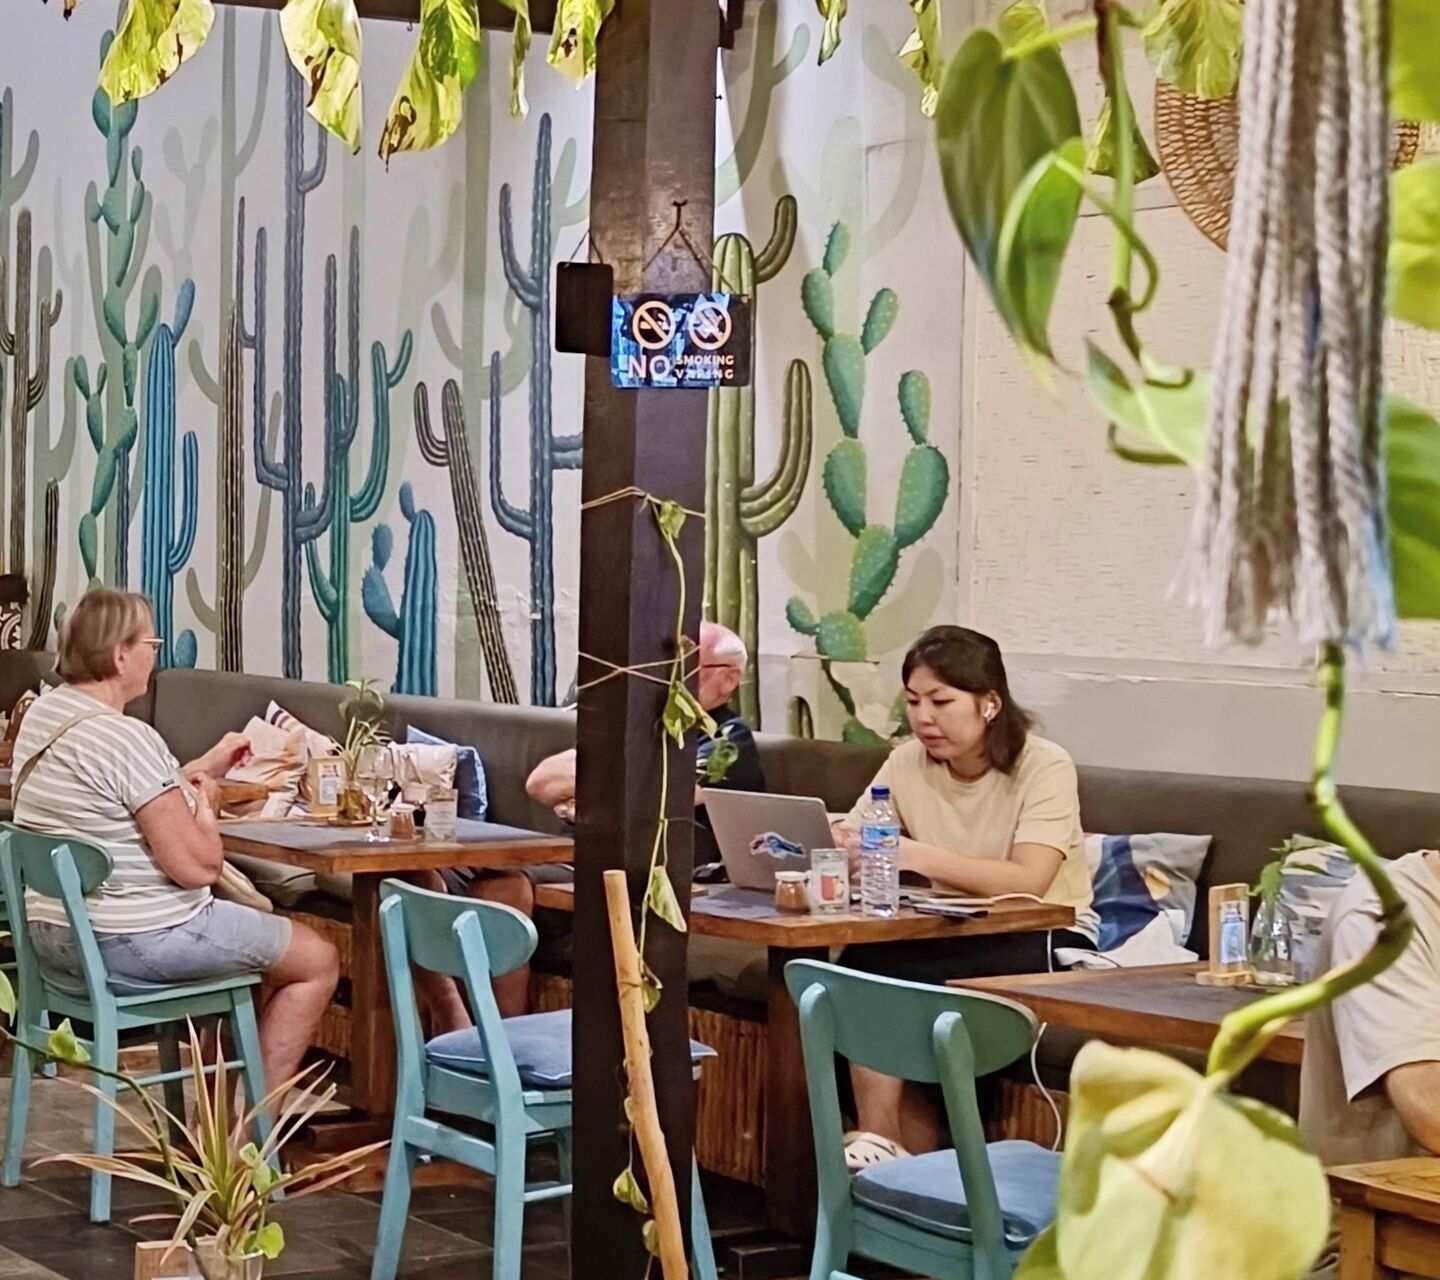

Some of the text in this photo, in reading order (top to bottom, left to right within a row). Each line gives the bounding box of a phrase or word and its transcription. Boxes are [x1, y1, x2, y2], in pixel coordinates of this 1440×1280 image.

[627, 355, 735, 380] NO SMOKING
[675, 369, 735, 380] VAPING
